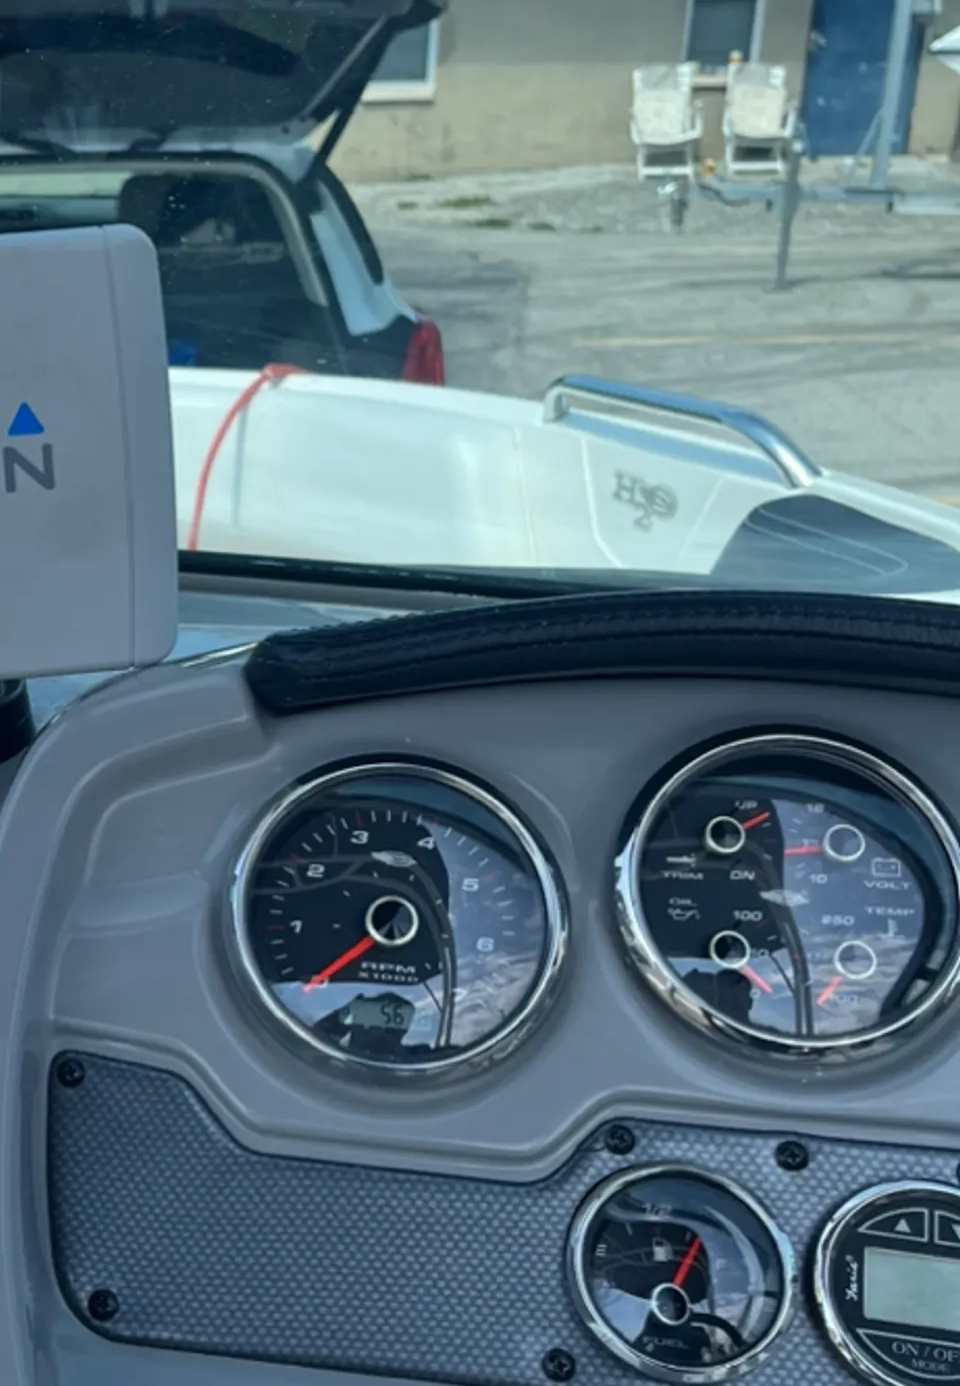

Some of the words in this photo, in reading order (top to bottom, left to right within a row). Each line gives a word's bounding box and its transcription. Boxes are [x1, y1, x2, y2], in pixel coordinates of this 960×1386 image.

[350, 830, 370, 845] 3
[417, 836, 437, 850] 4
[306, 863, 327, 879] 2
[461, 877, 480, 893] 5
[808, 873, 829, 885] 10
[861, 879, 912, 891] VOLT
[732, 909, 764, 922] 100
[863, 905, 916, 918] TEMP
[290, 919, 304, 934] 1
[476, 936, 495, 953] 6
[360, 961, 417, 973] RPM
